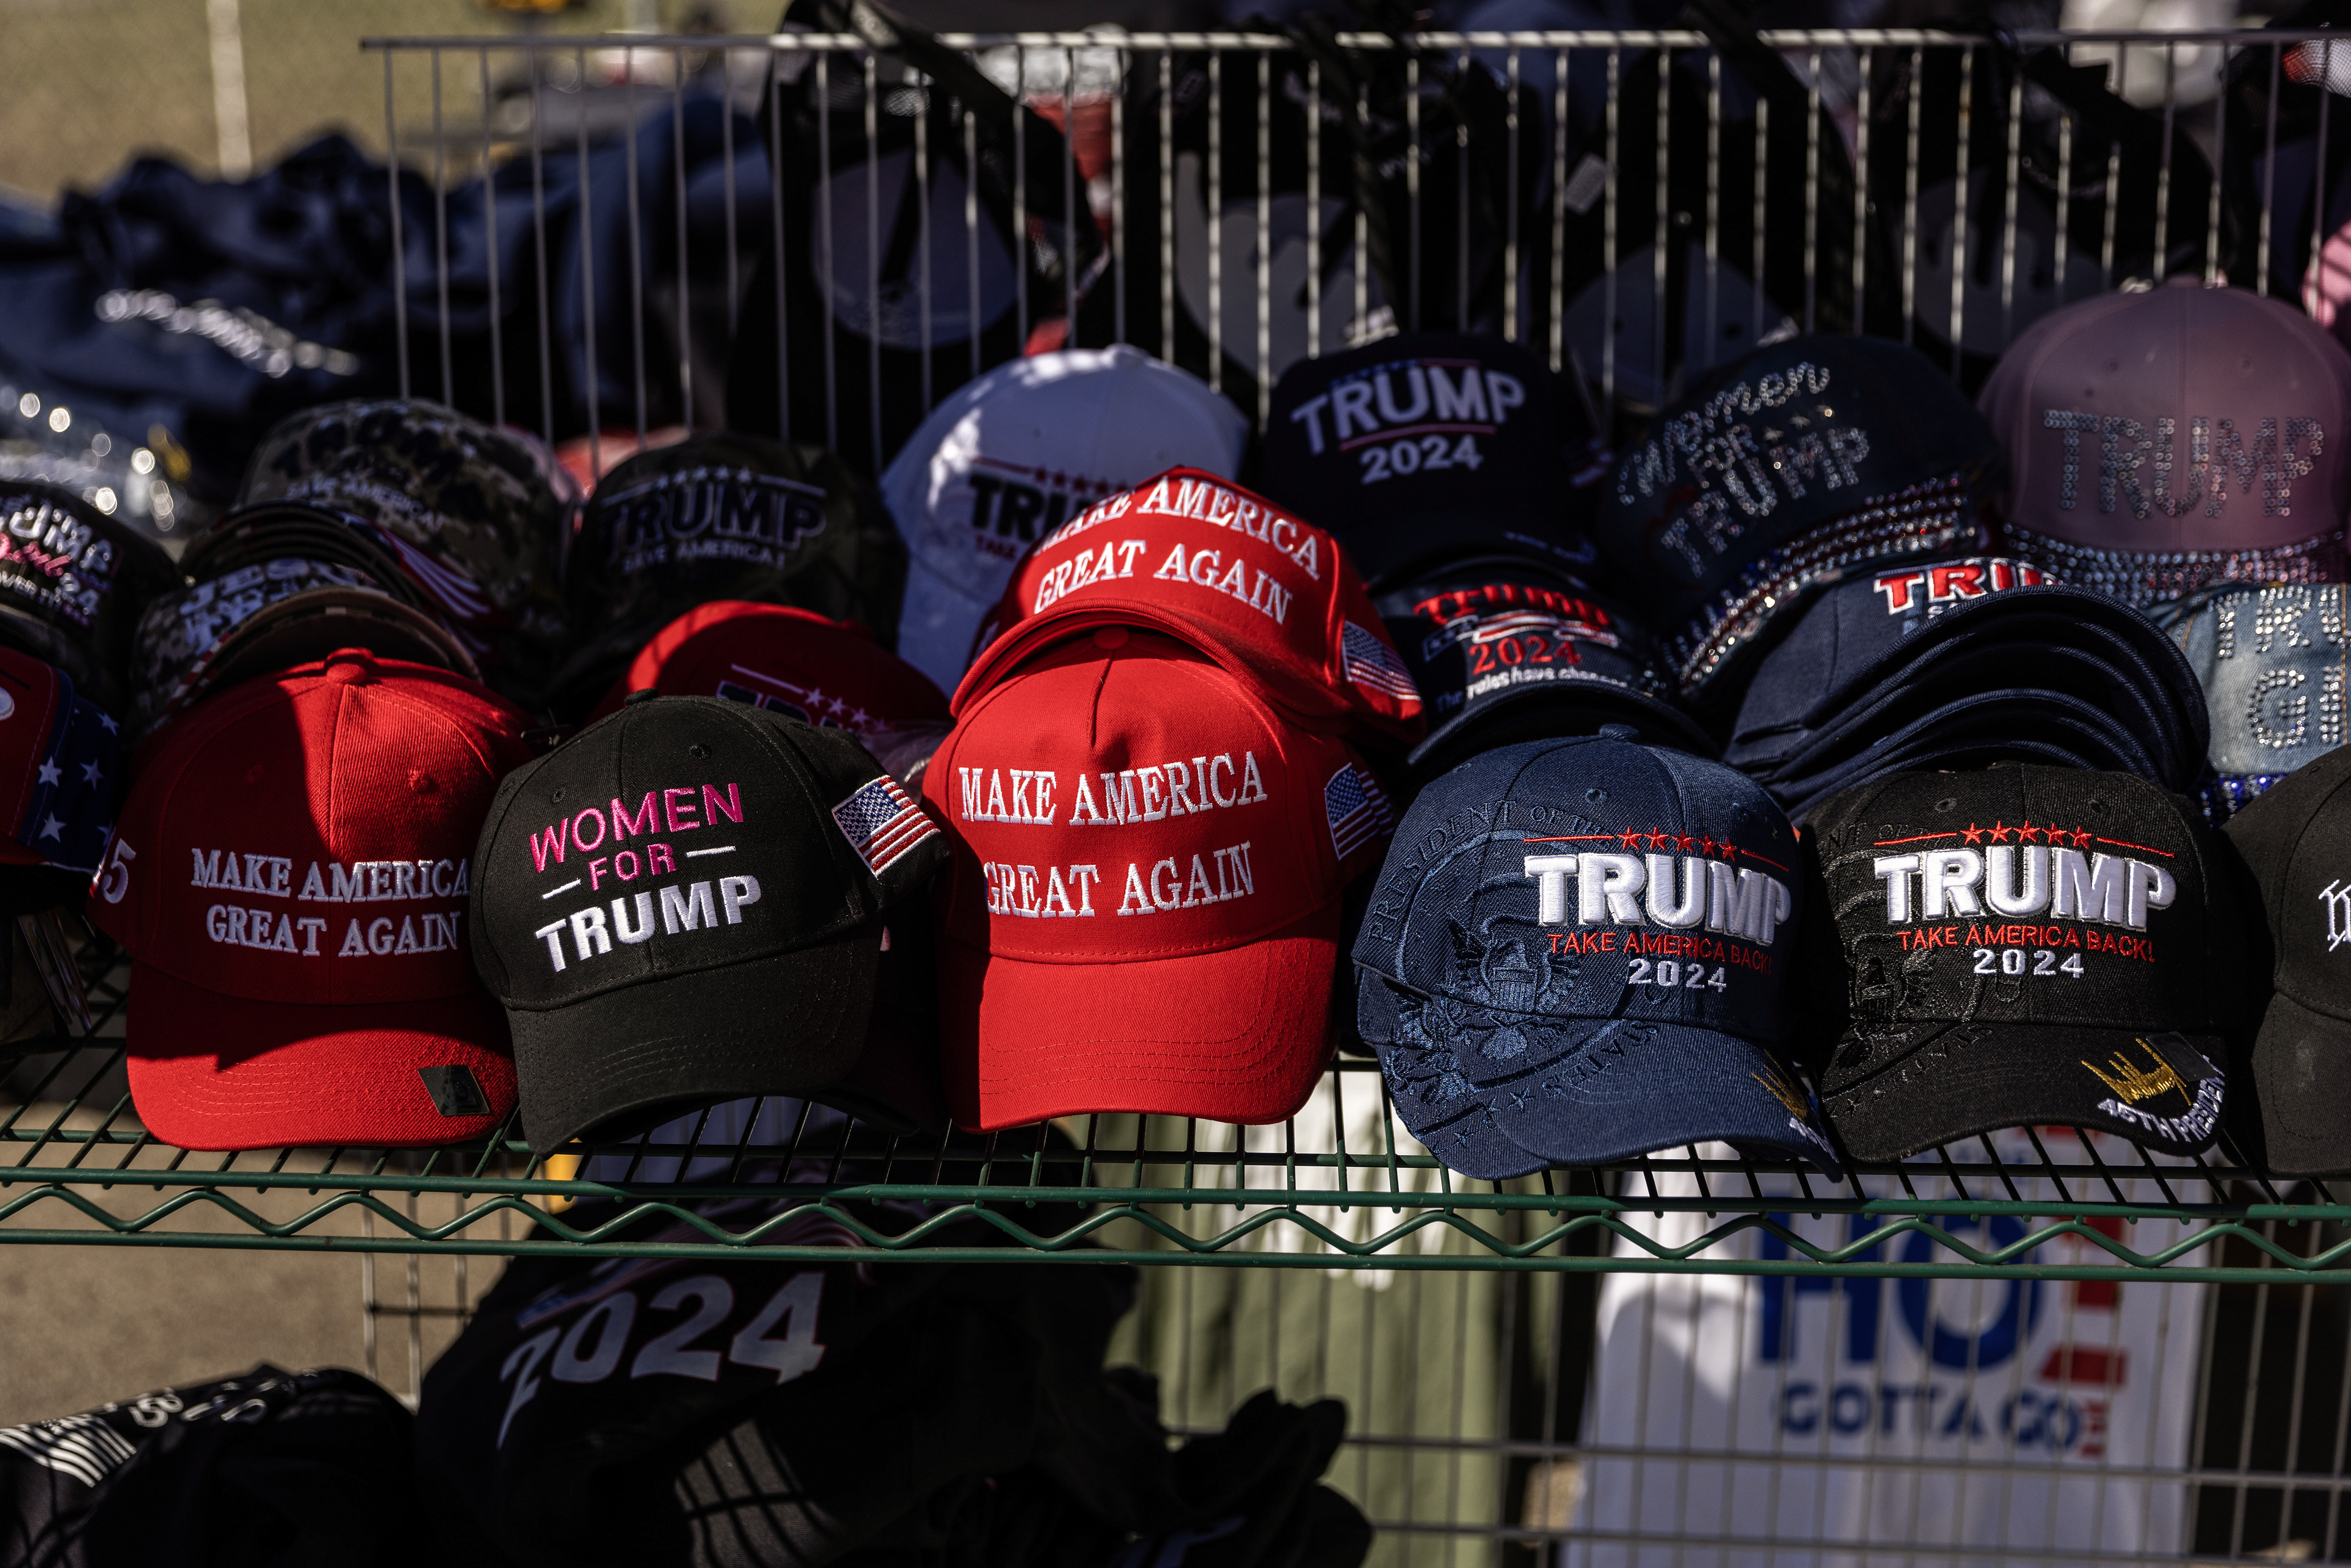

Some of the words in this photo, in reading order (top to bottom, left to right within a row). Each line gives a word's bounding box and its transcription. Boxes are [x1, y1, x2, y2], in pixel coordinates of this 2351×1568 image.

[1290, 365, 1526, 455] TRUMP
[1360, 434, 1484, 486] 2024
[2043, 408, 2324, 520] TRUMP
[596, 480, 828, 569] TRUMP
[1136, 475, 1320, 580] AMERICA
[1661, 427, 1870, 578] TRUMP
[1034, 539, 1147, 615] GREAT
[1153, 543, 1294, 625] AGAIN
[1873, 559, 2067, 616] TRU
[1466, 670, 1510, 701] rules
[1510, 666, 1555, 685] have
[1468, 635, 1581, 685] 2024
[959, 767, 1057, 826] MAKE
[1069, 751, 1268, 826] AMERICA
[529, 783, 744, 873] WOMEN
[190, 847, 292, 898] MAKE
[298, 858, 471, 903] AMERICA
[589, 843, 677, 891] FOR
[983, 861, 1101, 919] GREAT
[1117, 840, 1255, 917] AGAIN
[1366, 800, 1518, 943] PRESIDENT
[1530, 805, 1564, 827] OF
[1524, 852, 1791, 947] TRUMP
[1873, 845, 2177, 933] TRUMP
[206, 904, 327, 957] GREAT
[338, 911, 461, 957] AGAIN
[535, 875, 762, 973] TRUMP
[1547, 931, 1617, 955] TAKE
[1624, 932, 1729, 961] AMERICA
[1730, 944, 1773, 976] BACK!
[1896, 926, 1958, 952] TAKE
[1964, 925, 2079, 949] AMERICA
[2087, 930, 2156, 963] BACK!
[1628, 957, 1728, 993] 2024
[1973, 948, 2084, 979] 2024
[2097, 1097, 2177, 1142] 45TH
[497, 1269, 828, 1451] 2024
[1780, 1381, 1984, 1442] GOTTA
